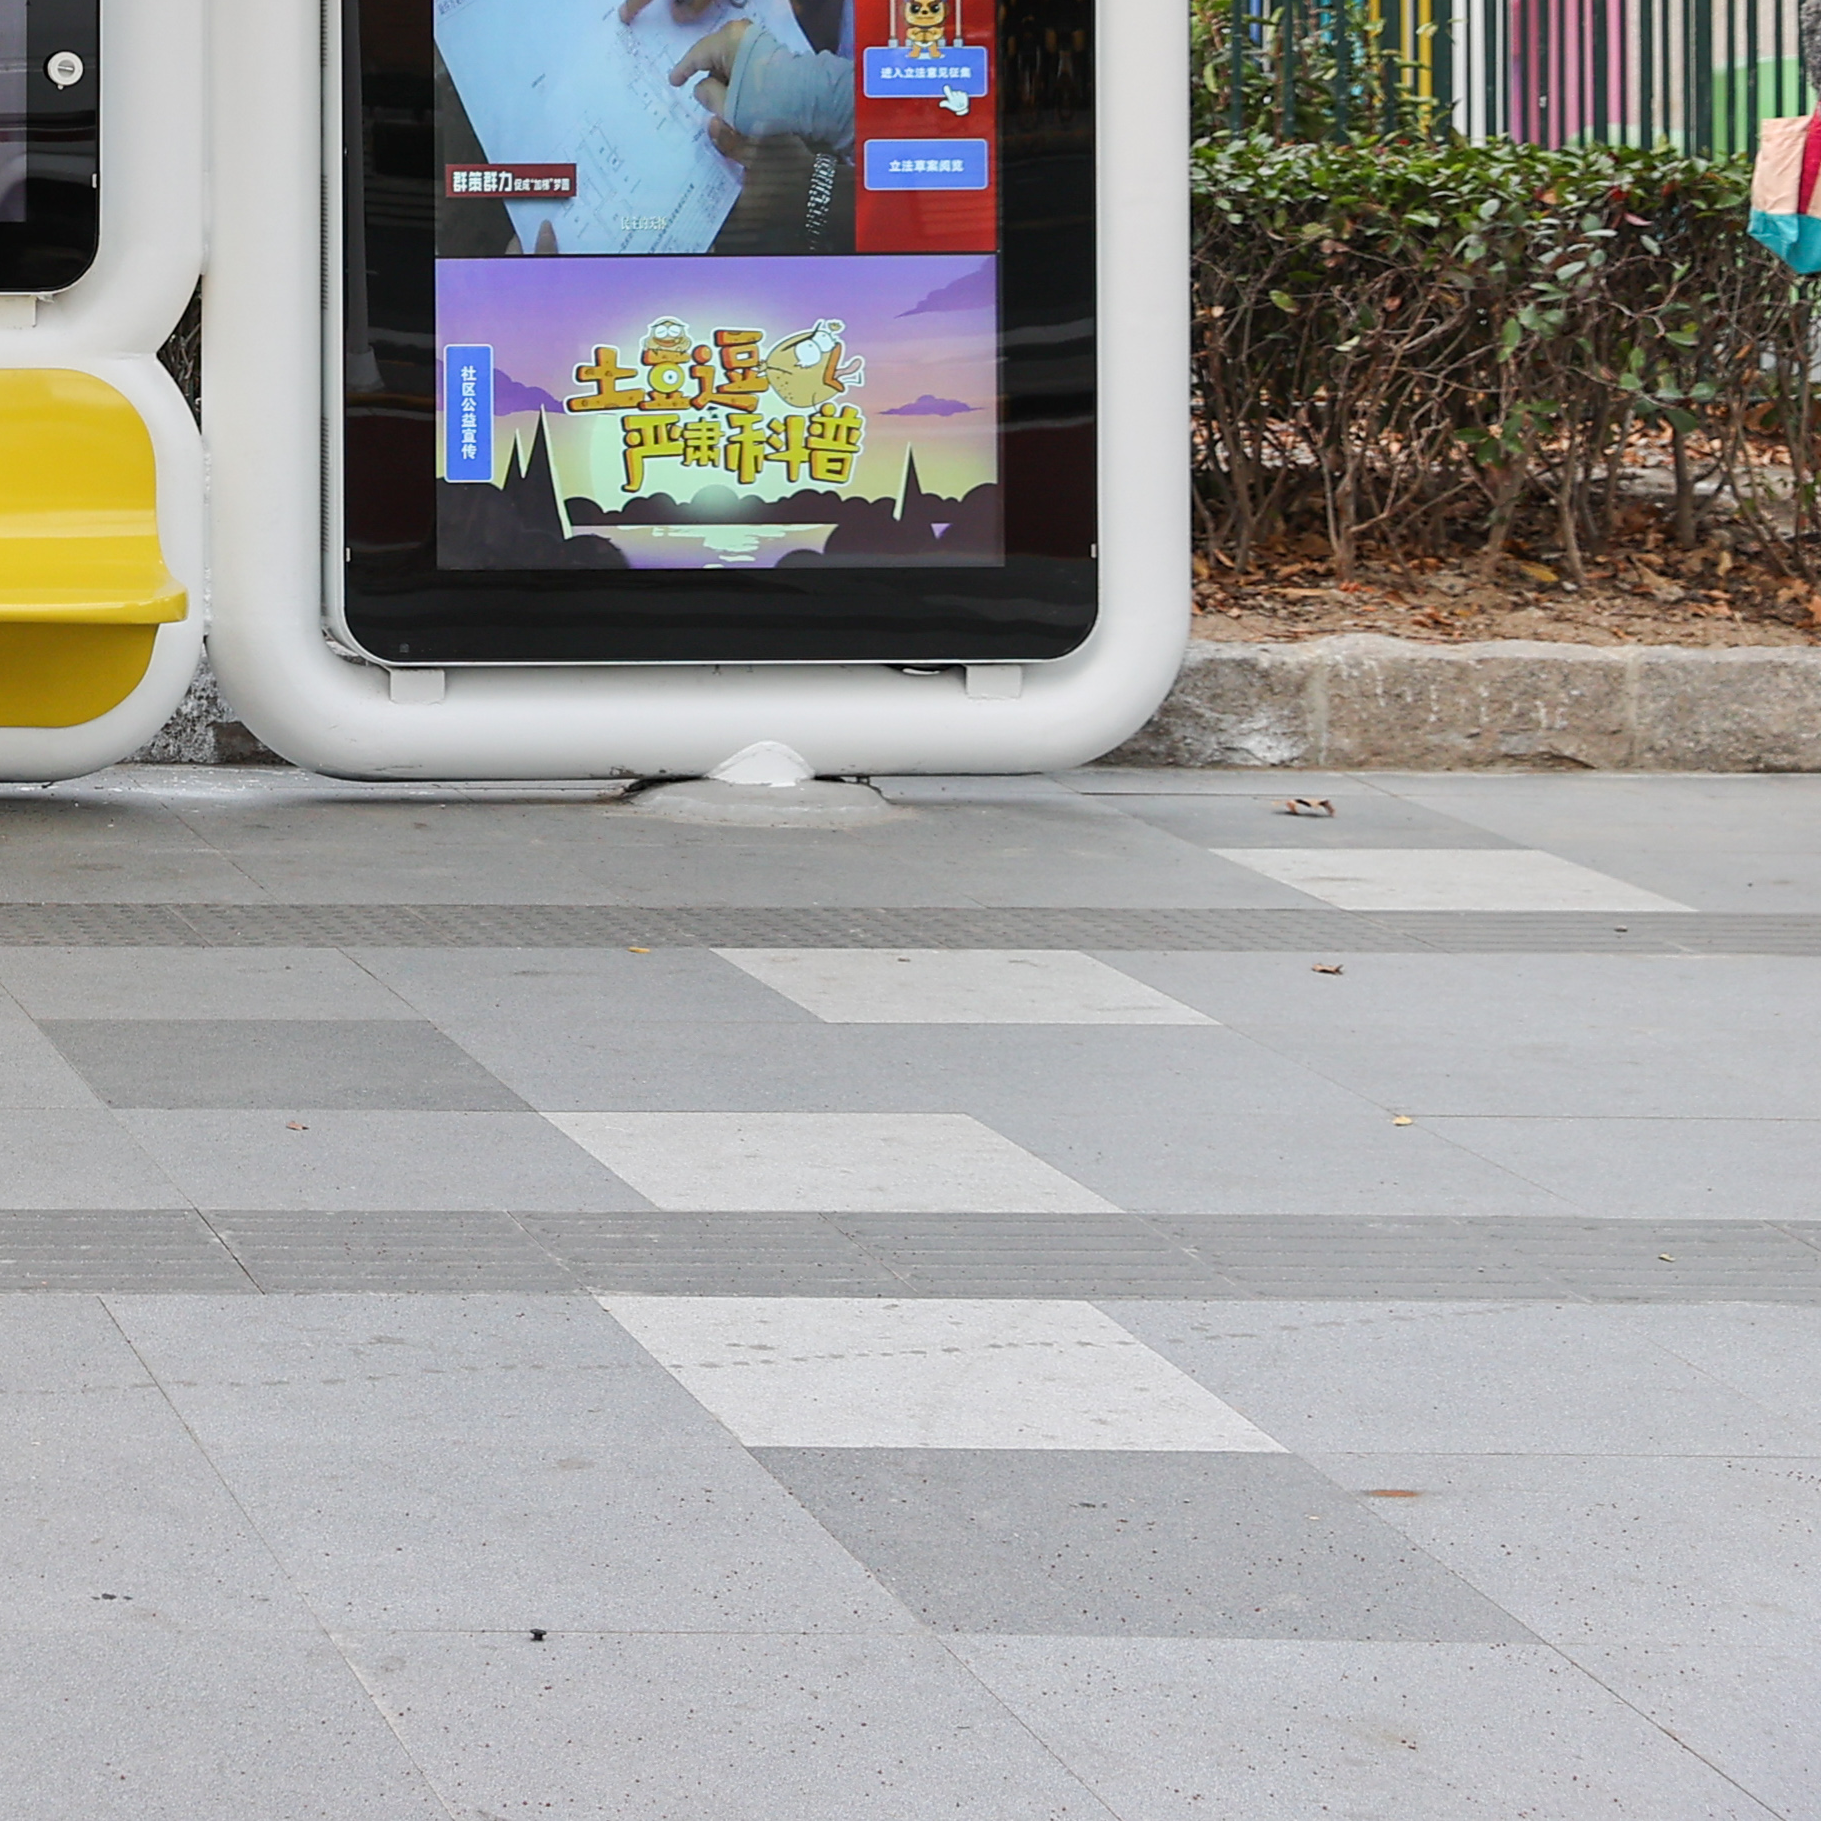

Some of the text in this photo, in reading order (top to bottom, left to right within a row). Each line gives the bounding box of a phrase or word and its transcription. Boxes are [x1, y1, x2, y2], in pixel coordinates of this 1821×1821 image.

[880, 66, 972, 79] 进入立法意见征集
[888, 159, 965, 173] 立法草案阅览
[452, 171, 513, 193] 群策群力
[461, 365, 478, 459] 社区公益宣传
[622, 402, 862, 492] 严肃科普
